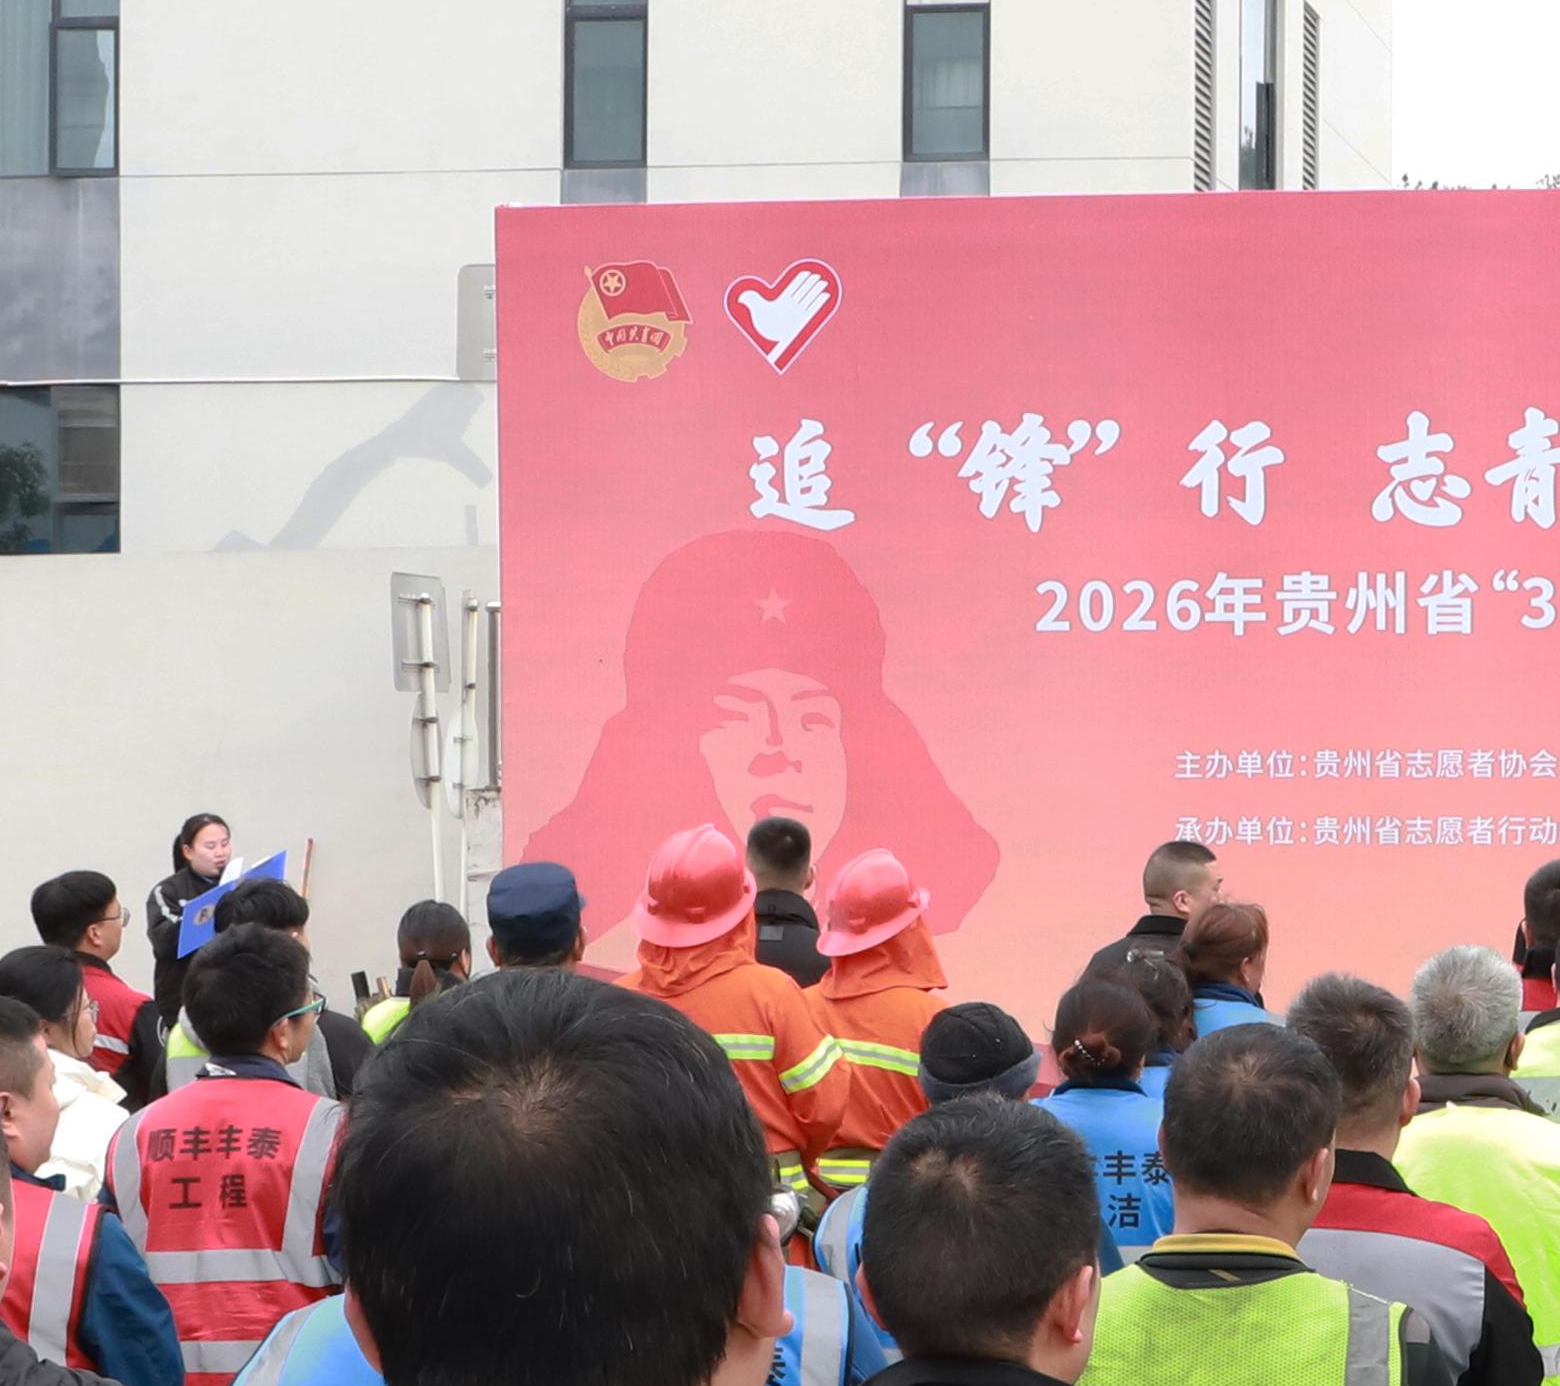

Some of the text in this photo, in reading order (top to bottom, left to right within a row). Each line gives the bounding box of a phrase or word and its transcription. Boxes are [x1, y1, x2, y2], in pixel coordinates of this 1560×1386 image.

[147, 1125, 282, 1162] 顺丰丰泰
[169, 1174, 249, 1210] 工程
